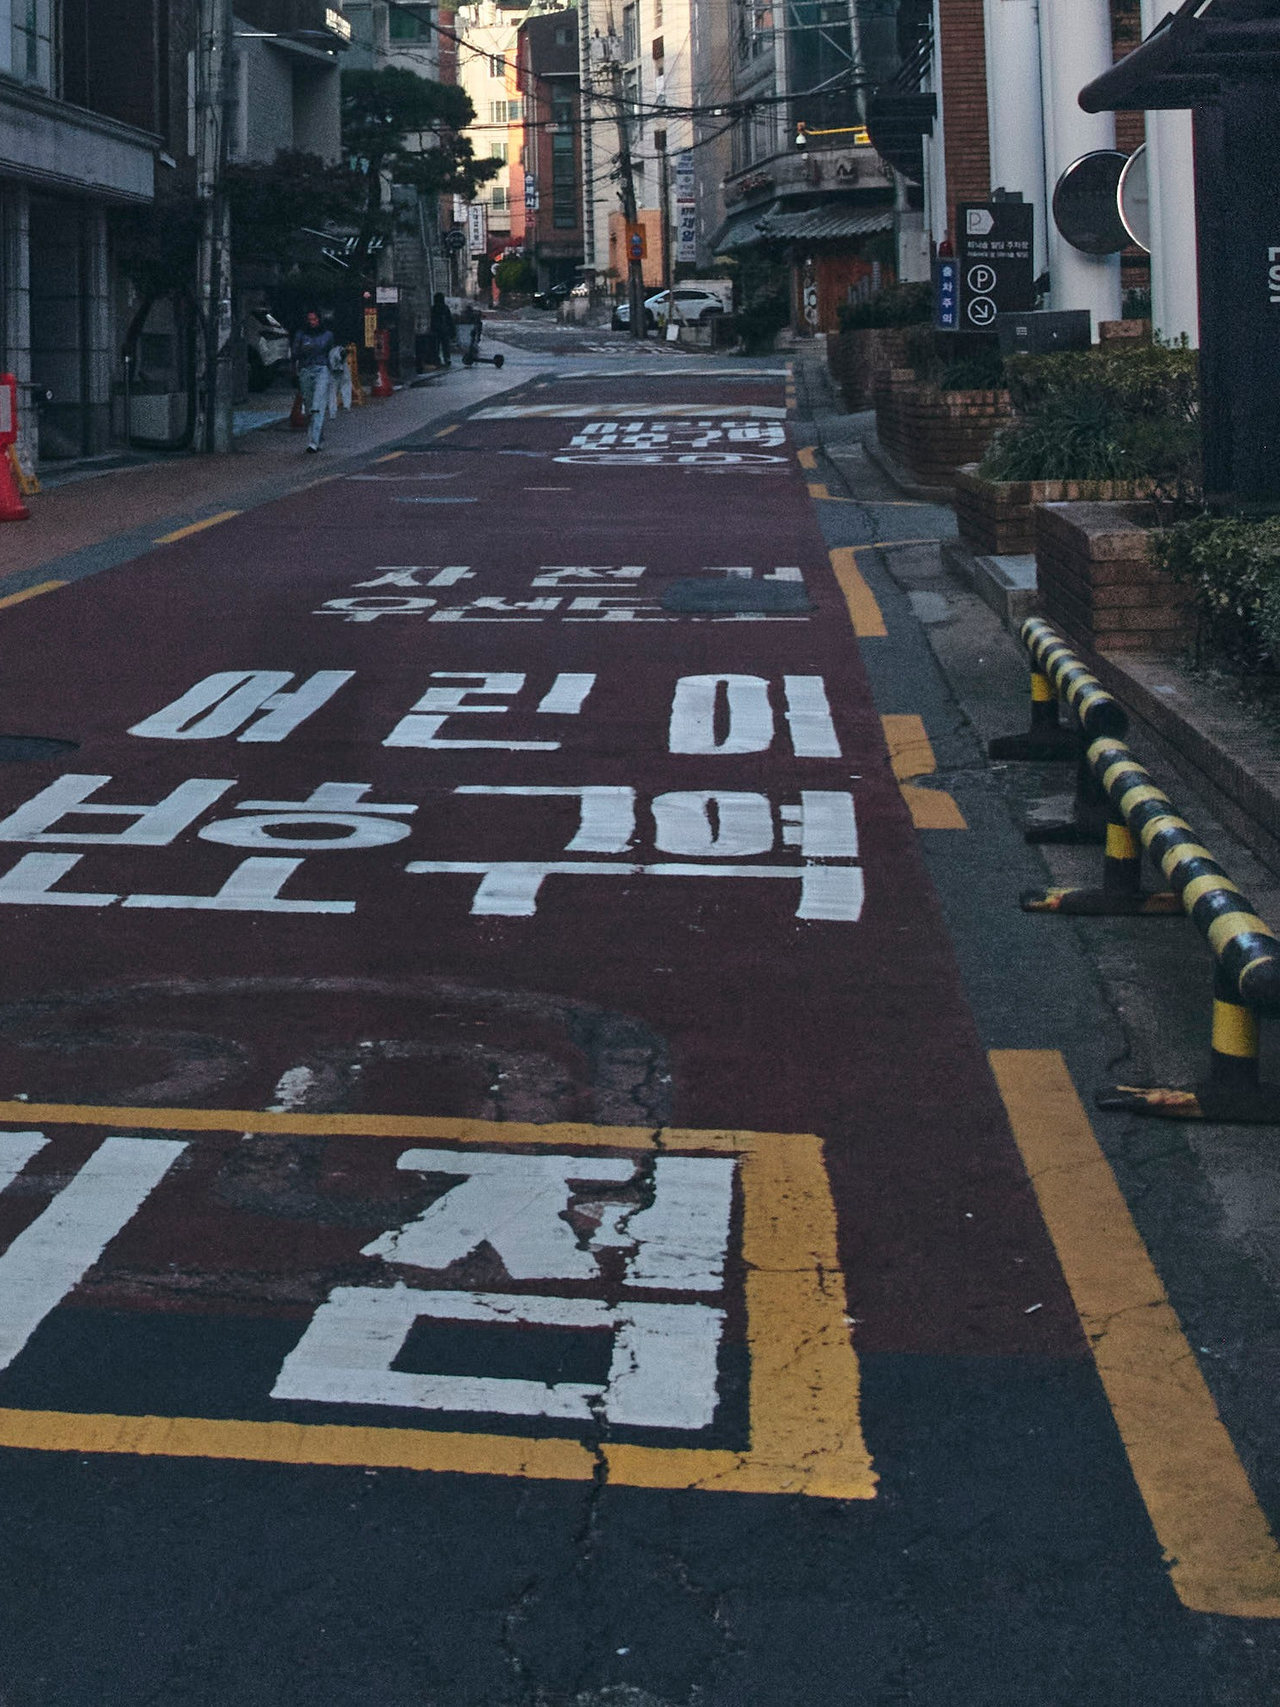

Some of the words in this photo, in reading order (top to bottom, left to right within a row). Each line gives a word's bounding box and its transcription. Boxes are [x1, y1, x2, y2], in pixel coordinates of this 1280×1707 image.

[977, 270, 988, 288] P
[311, 596, 810, 623] 우선도
[126, 670, 842, 758] 어린이
